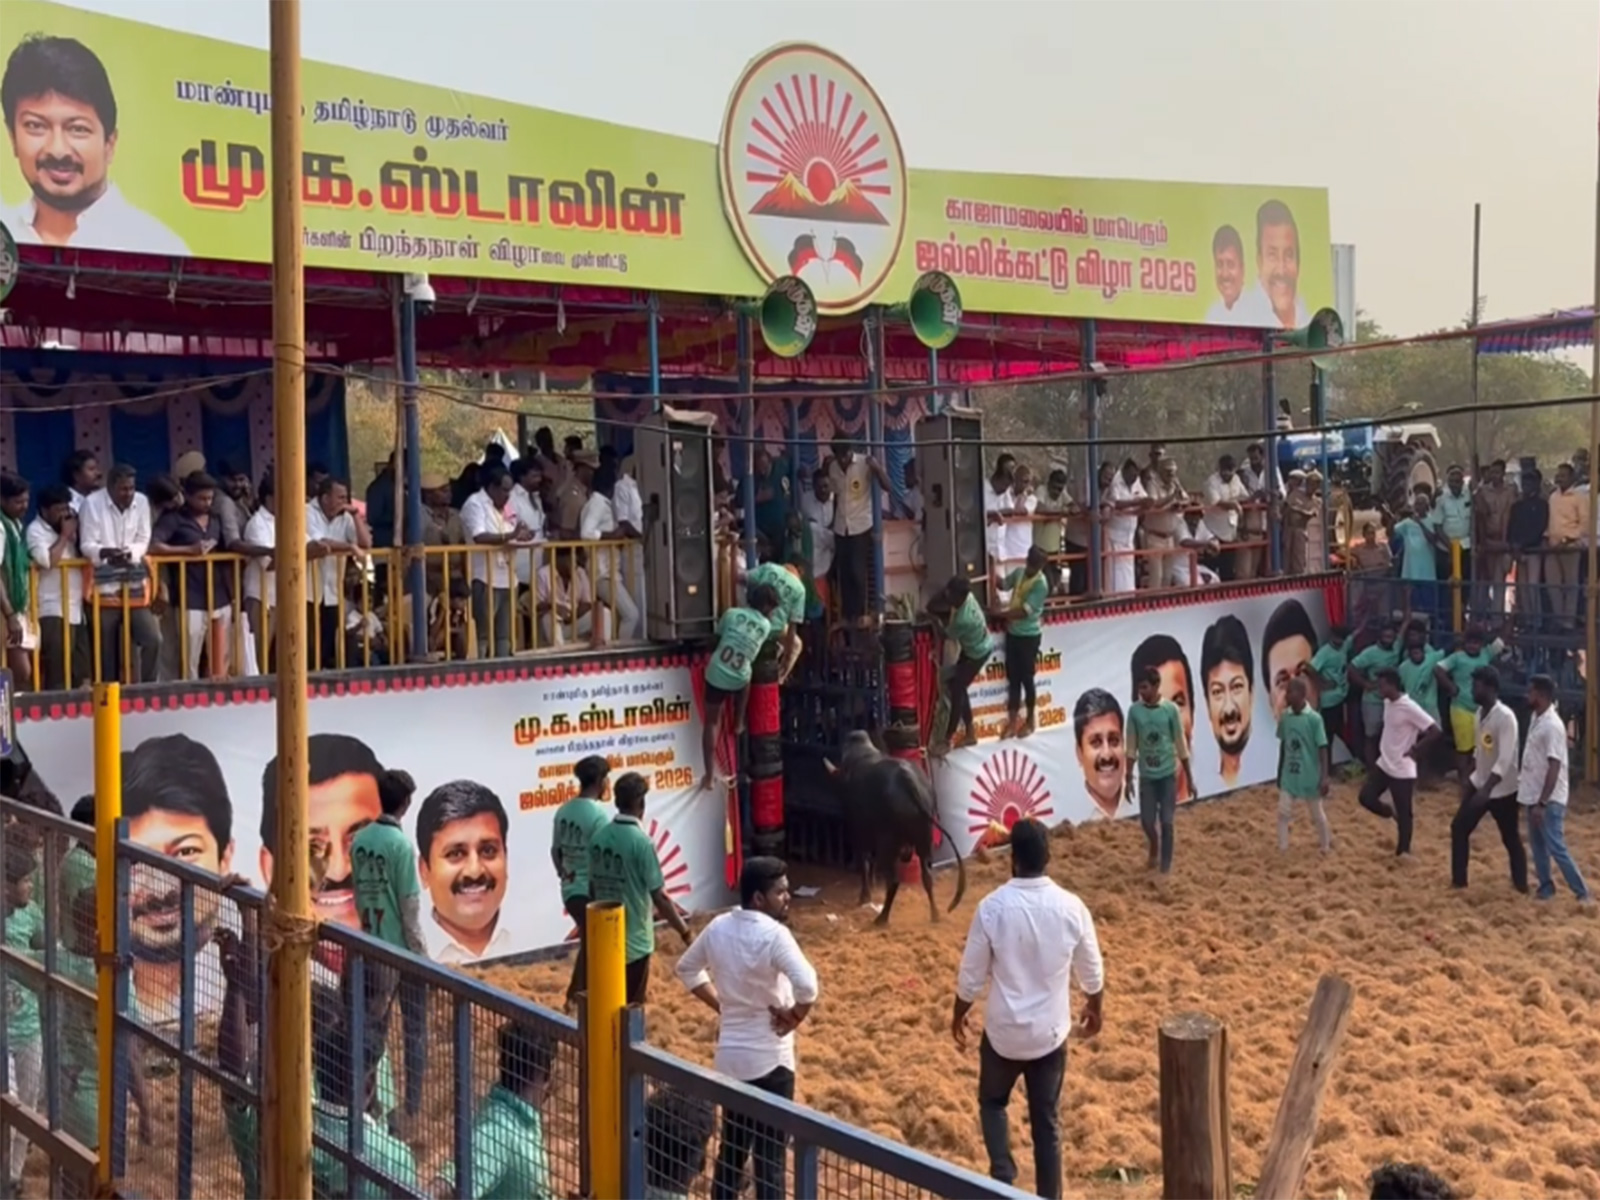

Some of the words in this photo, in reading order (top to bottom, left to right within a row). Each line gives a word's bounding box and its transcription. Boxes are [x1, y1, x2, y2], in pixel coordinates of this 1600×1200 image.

[313, 97, 417, 134] தமிழ்நாடு
[425, 114, 509, 141] முதல்வர்
[946, 198, 1088, 235] காஜாமலையில்
[1093, 216, 1168, 246] மாபெரும்
[359, 225, 480, 260] பிறந்தநாள்
[489, 237, 565, 268] விழாவை
[915, 232, 1070, 290] ஜல்லிக்கட்டு
[1075, 249, 1133, 298] விழா
[1139, 256, 1197, 292] 2026
[720, 645, 745, 670] 03
[514, 694, 691, 745] மு.க.ஸ்டாலின்
[655, 766, 693, 789] 2026
